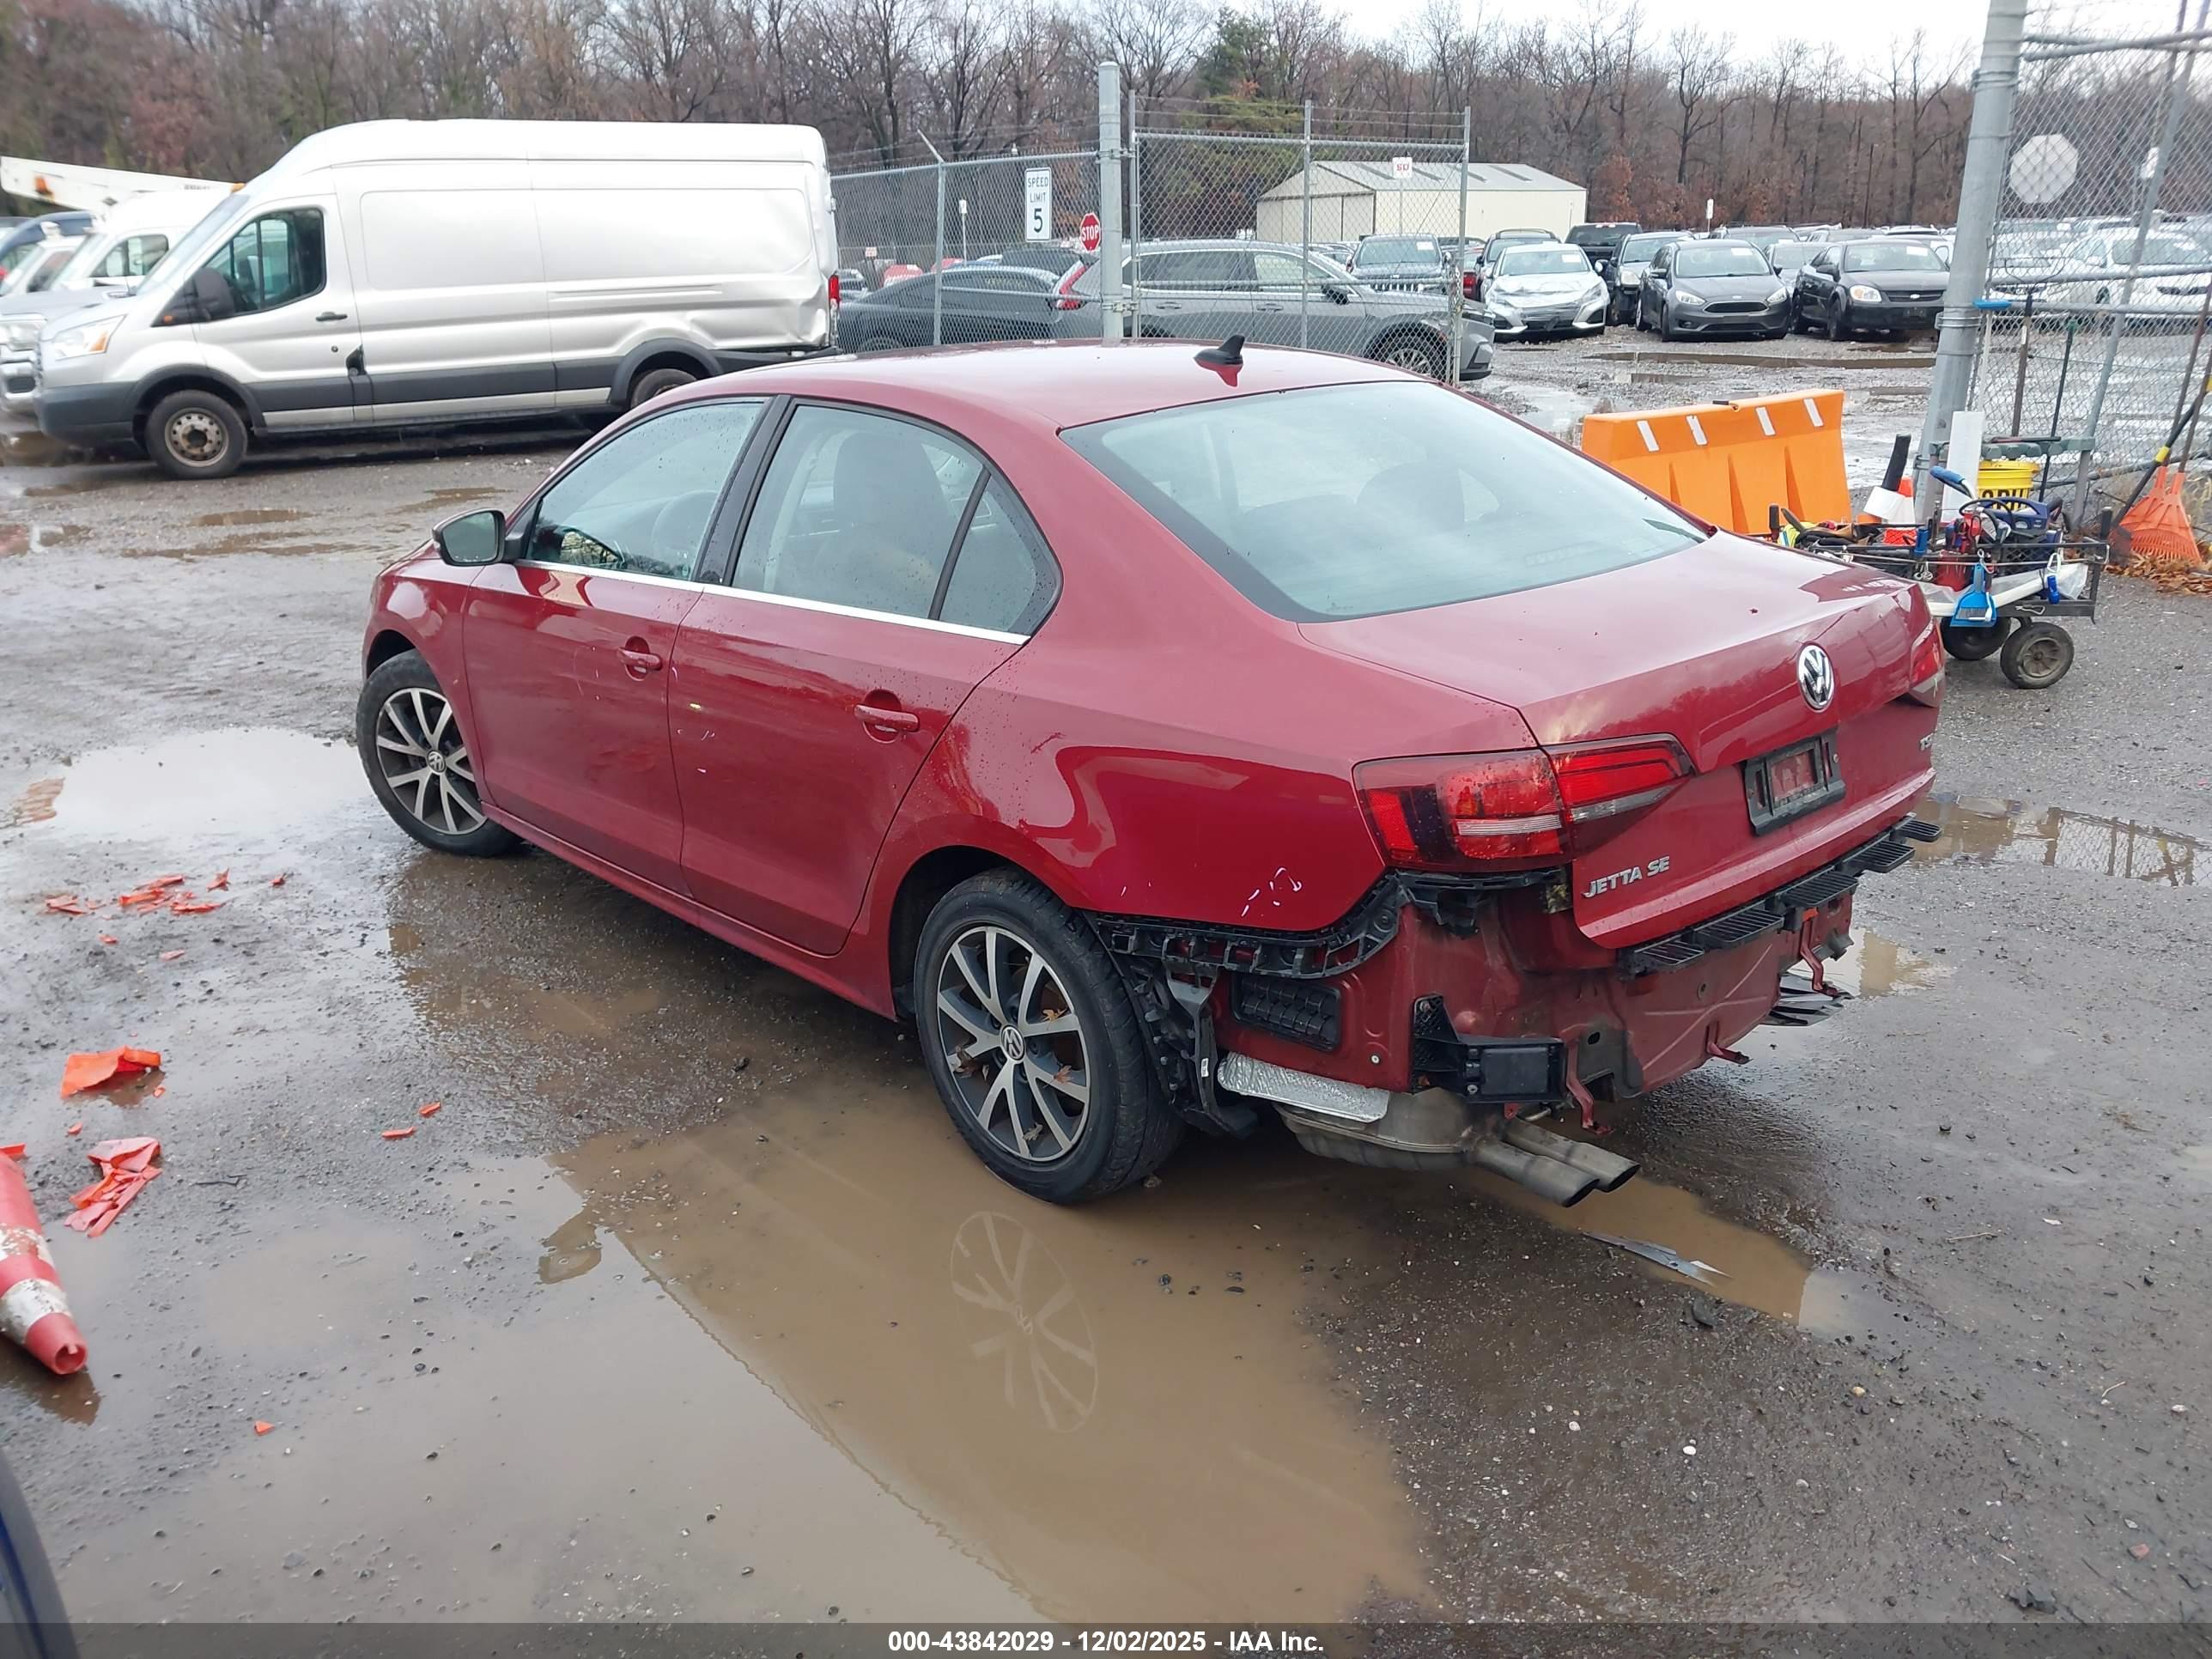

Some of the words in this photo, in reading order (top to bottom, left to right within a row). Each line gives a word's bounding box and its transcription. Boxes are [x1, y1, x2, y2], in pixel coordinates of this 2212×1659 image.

[1028, 177, 1048, 187] SPEED
[1030, 191, 1046, 203] LIMIT
[1033, 208, 1043, 233] 5
[1081, 224, 1099, 240] STOP
[1581, 866, 1643, 898] JETTA
[1647, 856, 1670, 877] SE
